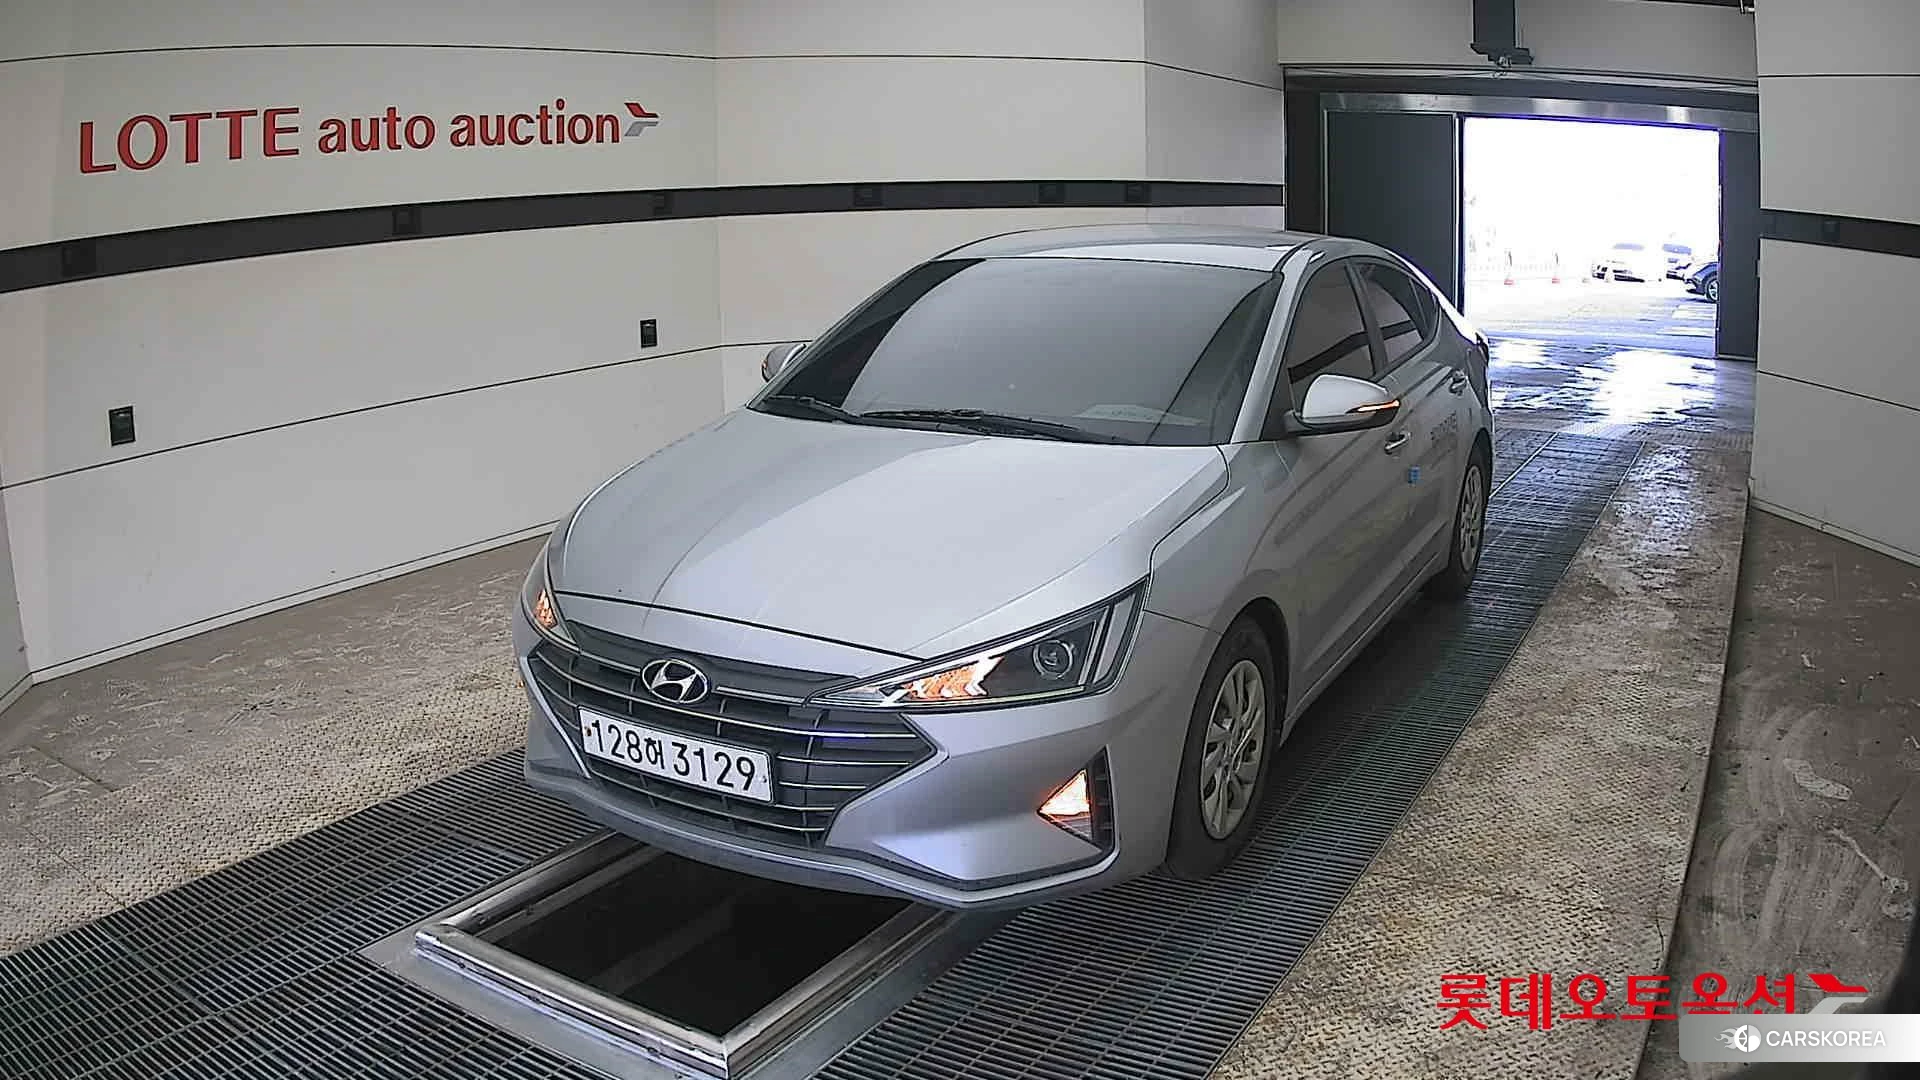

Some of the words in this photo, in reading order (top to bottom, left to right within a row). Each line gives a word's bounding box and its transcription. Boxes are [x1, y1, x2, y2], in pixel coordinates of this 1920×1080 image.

[79, 107, 300, 174] LOTTE
[318, 106, 436, 154] auto
[450, 98, 621, 148] auction
[671, 741, 756, 791] 3129
